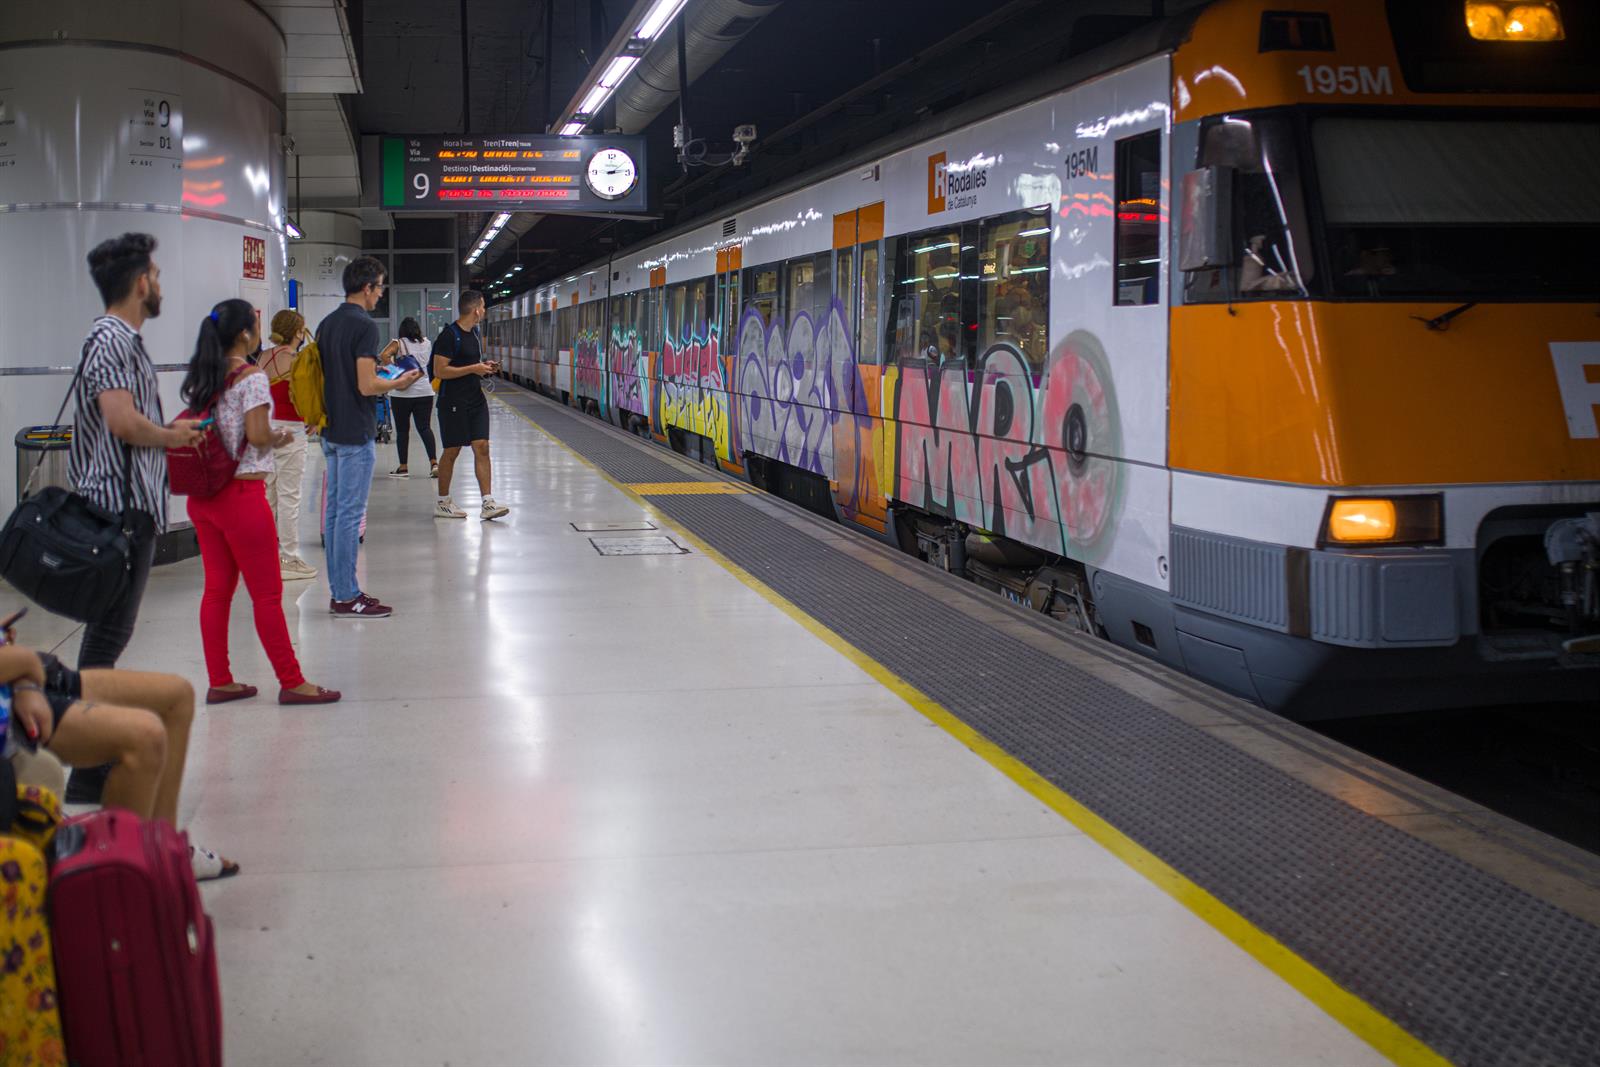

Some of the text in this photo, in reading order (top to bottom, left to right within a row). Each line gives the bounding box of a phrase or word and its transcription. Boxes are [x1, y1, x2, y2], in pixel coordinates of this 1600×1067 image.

[1297, 65, 1393, 95] 195M
[159, 100, 170, 128] 9
[160, 136, 172, 150] D1
[443, 165, 469, 173] Destino
[472, 164, 509, 173] Destinació
[1065, 145, 1098, 180] 195M
[413, 173, 430, 200] 9
[948, 165, 987, 196] Rodalies
[352, 603, 366, 613] N
